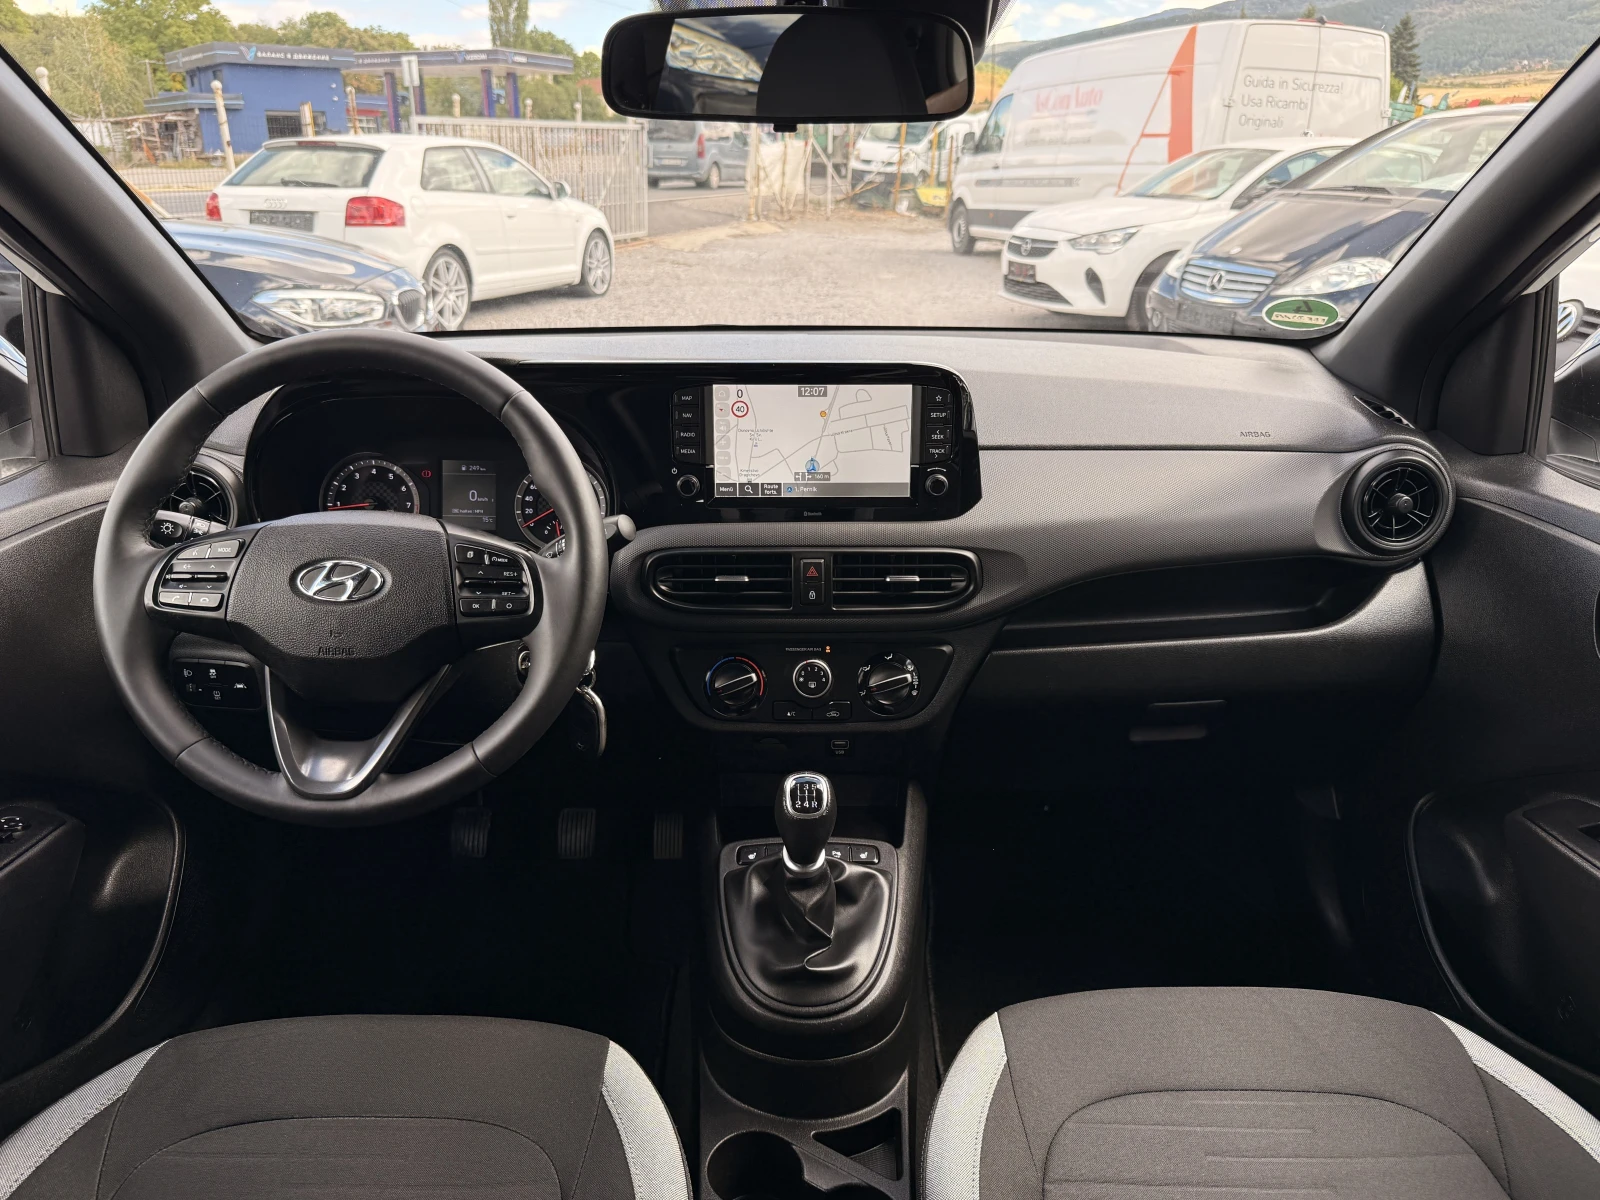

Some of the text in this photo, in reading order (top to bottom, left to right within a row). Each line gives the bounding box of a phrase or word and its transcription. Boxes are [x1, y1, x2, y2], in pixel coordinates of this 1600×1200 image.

[1243, 74, 1344, 95] Guida in Sicurezza!
[1241, 94, 1308, 111] Usa Ricambi
[1238, 113, 1284, 131] Originali
[736, 389, 744, 398] 0
[799, 387, 825, 396] 12:07
[735, 405, 745, 413] 40
[469, 490, 478, 501] 0
